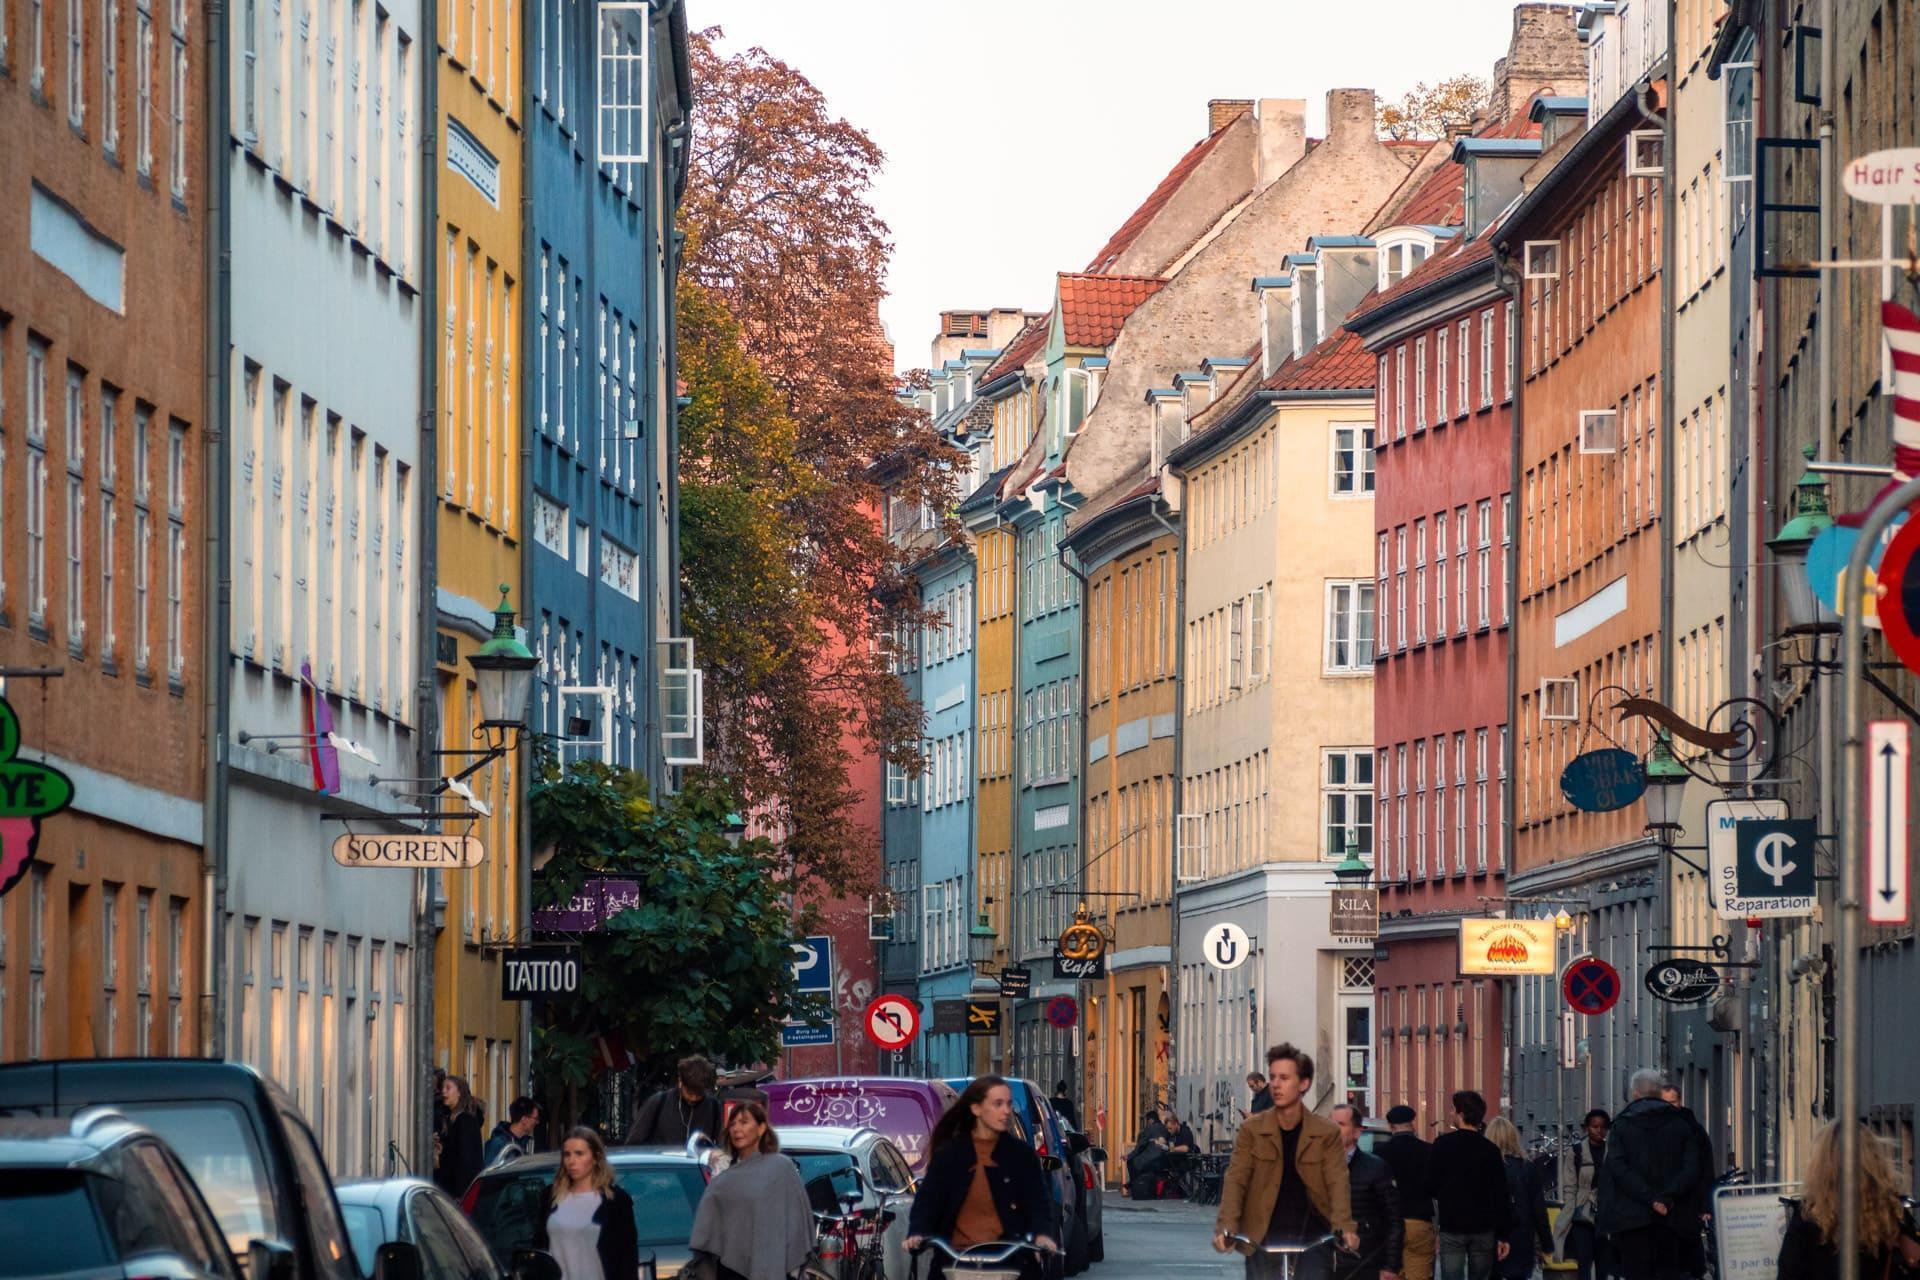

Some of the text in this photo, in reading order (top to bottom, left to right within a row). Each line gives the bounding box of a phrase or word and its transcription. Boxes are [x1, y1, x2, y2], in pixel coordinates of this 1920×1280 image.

[1854, 163, 1904, 185] Hair
[1339, 898, 1371, 911] KILA
[1725, 897, 1810, 915] Reparation
[506, 960, 577, 993] TATTOO
[1060, 959, 1099, 978] Café
[884, 1134, 922, 1151] AY
